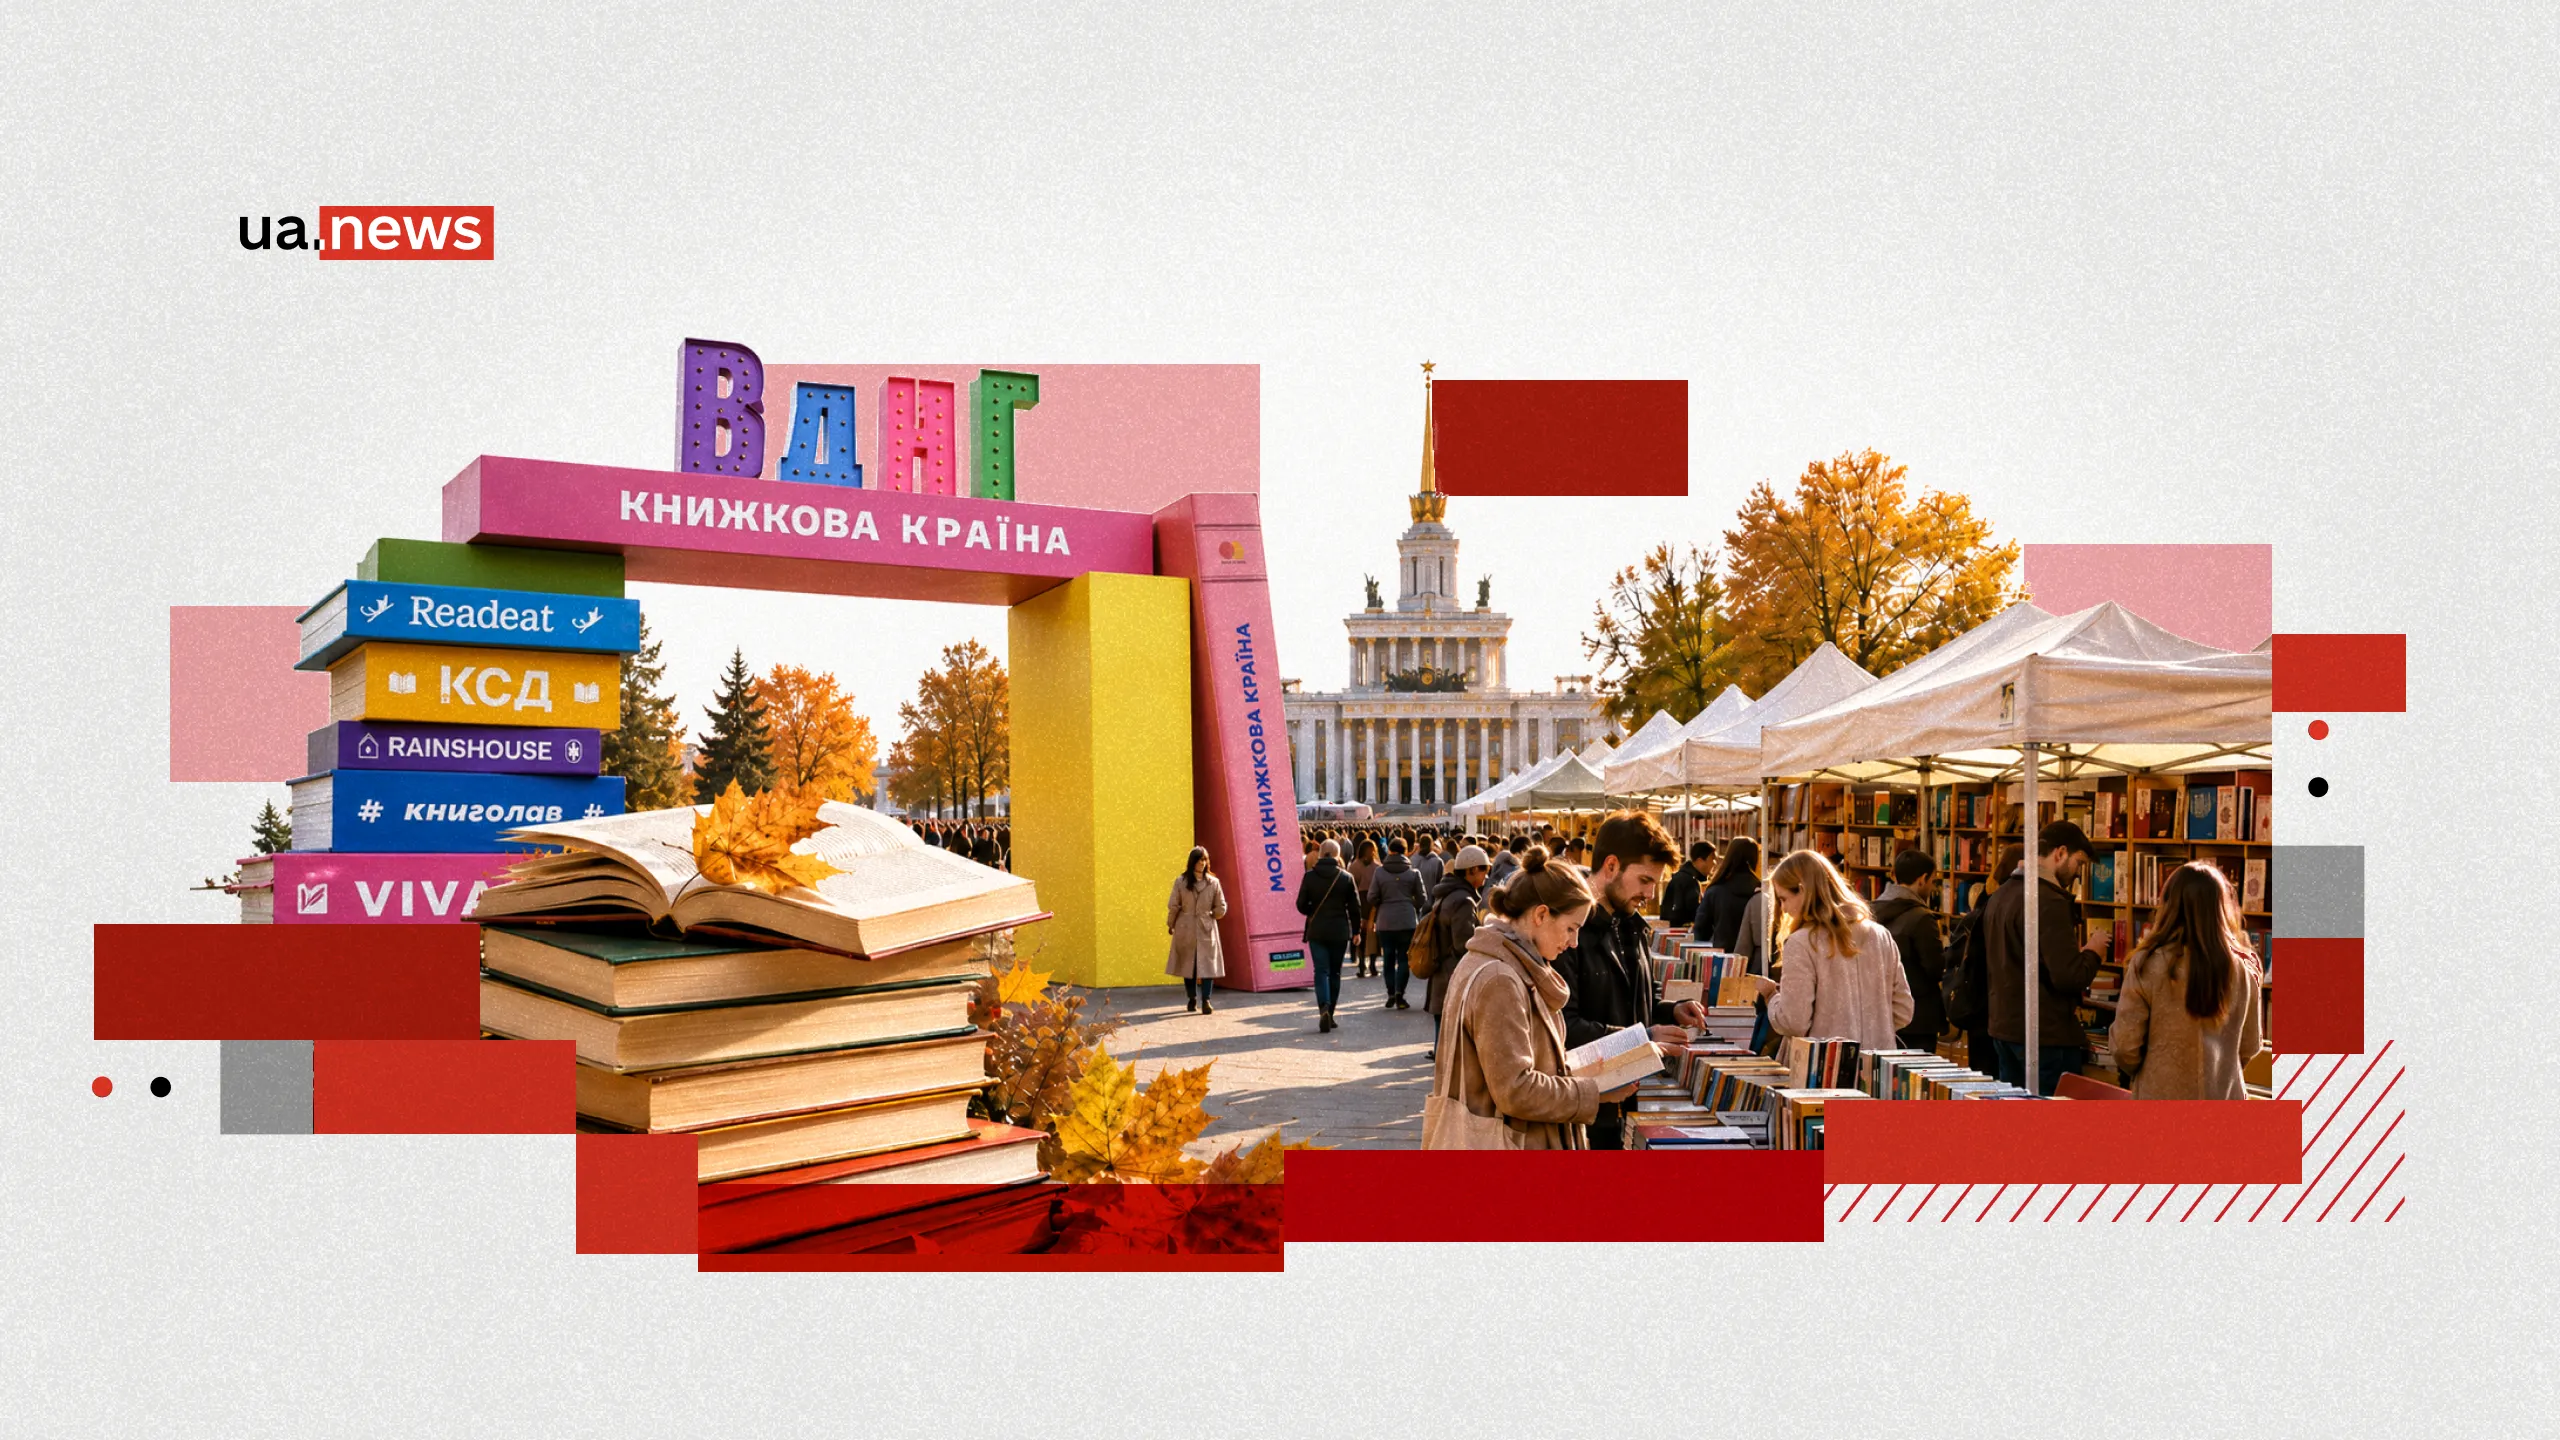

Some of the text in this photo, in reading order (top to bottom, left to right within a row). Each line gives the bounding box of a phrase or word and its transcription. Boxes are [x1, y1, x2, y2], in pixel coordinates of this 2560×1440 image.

[674, 337, 1040, 502] ВДНГ
[619, 489, 1071, 556] КНИЖКОВА КРАЇНА
[408, 595, 555, 633] Readeat
[440, 664, 553, 713] КСД
[388, 735, 553, 762] RAINSHOUSE
[1234, 622, 1286, 892] МОЯ КНИЖКОВА КРАЇНА
[403, 801, 564, 824] книголав
